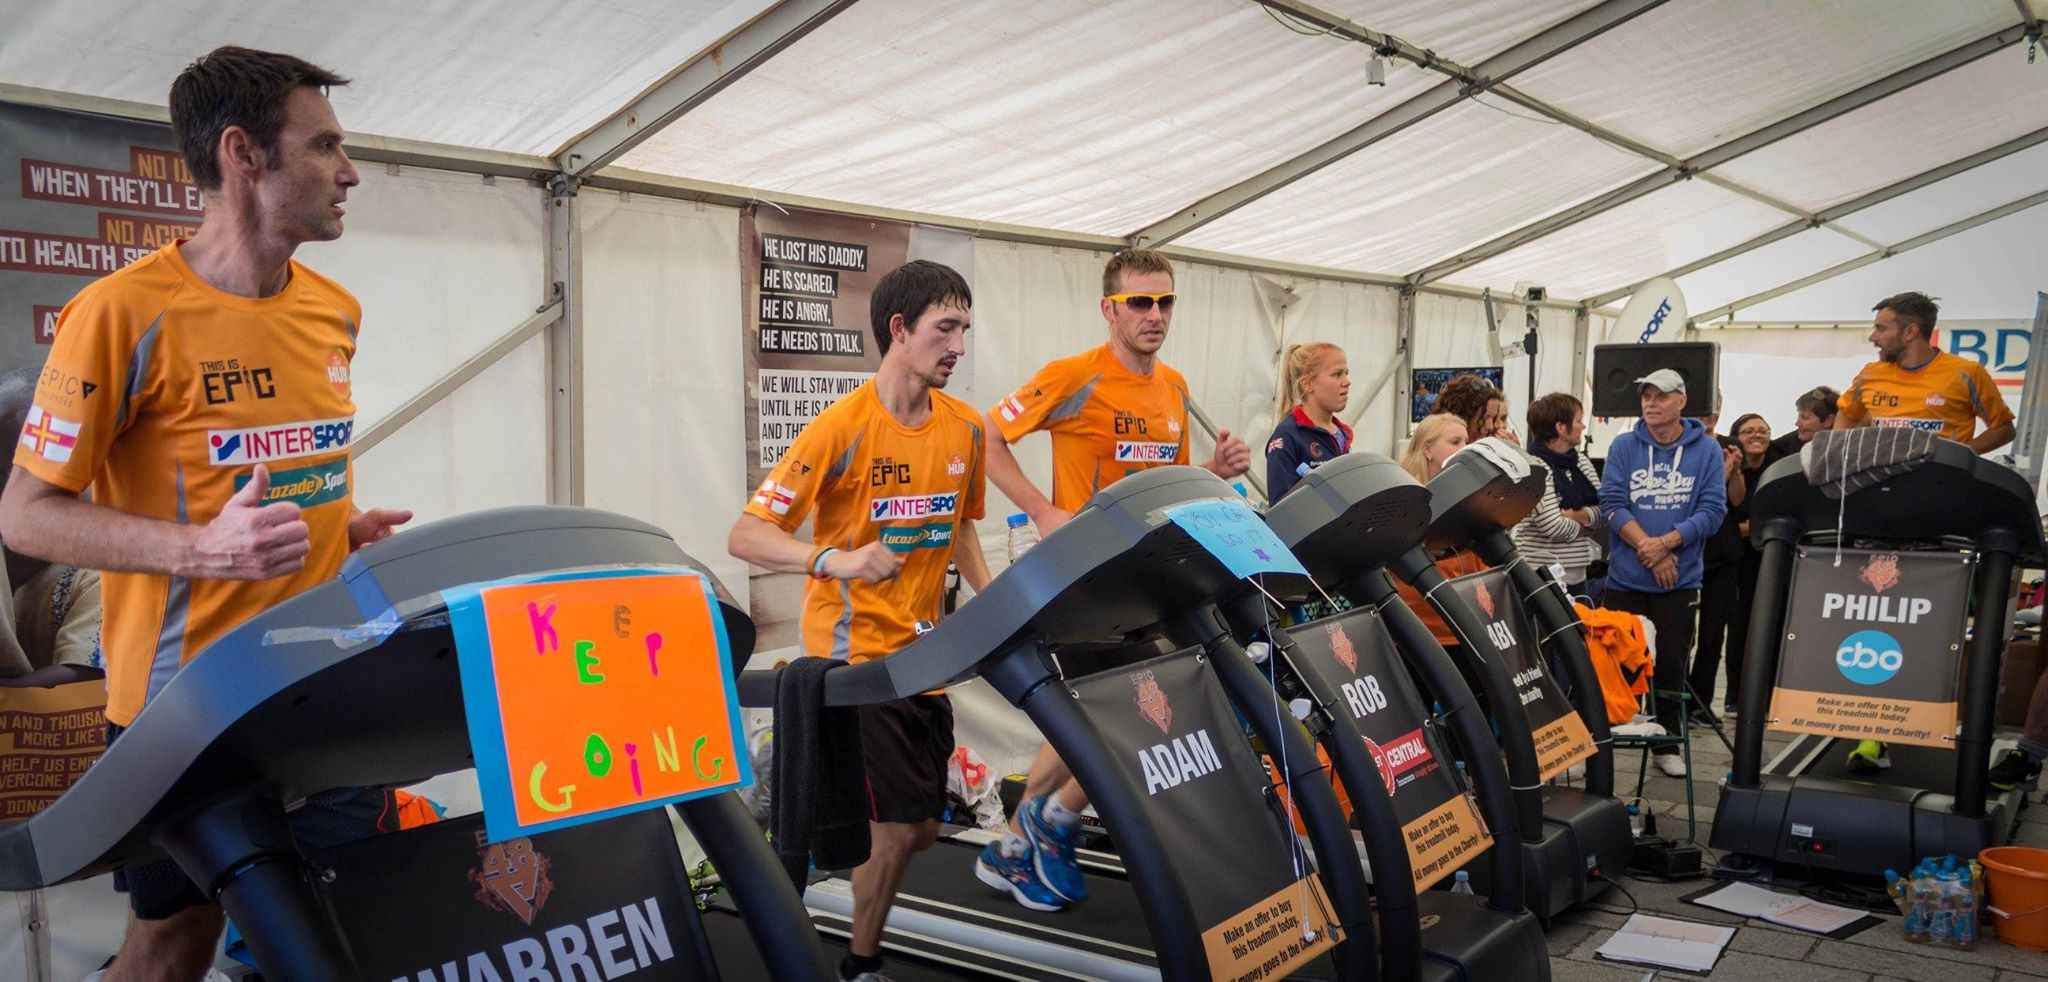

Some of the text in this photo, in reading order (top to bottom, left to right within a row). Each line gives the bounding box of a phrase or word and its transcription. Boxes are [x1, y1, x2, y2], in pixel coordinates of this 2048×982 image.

[138, 153, 166, 180] NO
[30, 166, 90, 198] WHEN
[96, 174, 180, 208] THEY'LL
[106, 219, 134, 245] NO
[35, 239, 116, 271] HEALTH
[764, 238, 865, 270] HE LOST HIS DADDY,
[764, 269, 836, 295] HE IS SCARED,
[762, 299, 831, 325] HE IS ANGRY,
[762, 330, 862, 353] HE NEEDS TO TALK.
[1951, 329, 2032, 372] BD
[203, 366, 276, 405] EPIC
[762, 376, 777, 392] WE
[781, 377, 807, 393] WILL
[810, 377, 834, 394] STAY
[762, 400, 791, 416] UNTIL
[795, 401, 808, 416] HE
[245, 420, 354, 459] INTERSPOR
[762, 423, 782, 439] AND
[763, 446, 774, 462] AS
[872, 462, 911, 487] EPIC
[1822, 593, 1932, 624] PHILIP
[527, 600, 664, 686] KEEP
[1341, 675, 1388, 719] ROB
[12, 716, 42, 730] AND
[22, 731, 62, 747] MORE
[66, 728, 95, 745] LIKE
[2, 758, 40, 773] HELP
[44, 758, 65, 771] US
[1138, 728, 1223, 796] ADAM
[1387, 737, 1426, 768] CENTRAL
